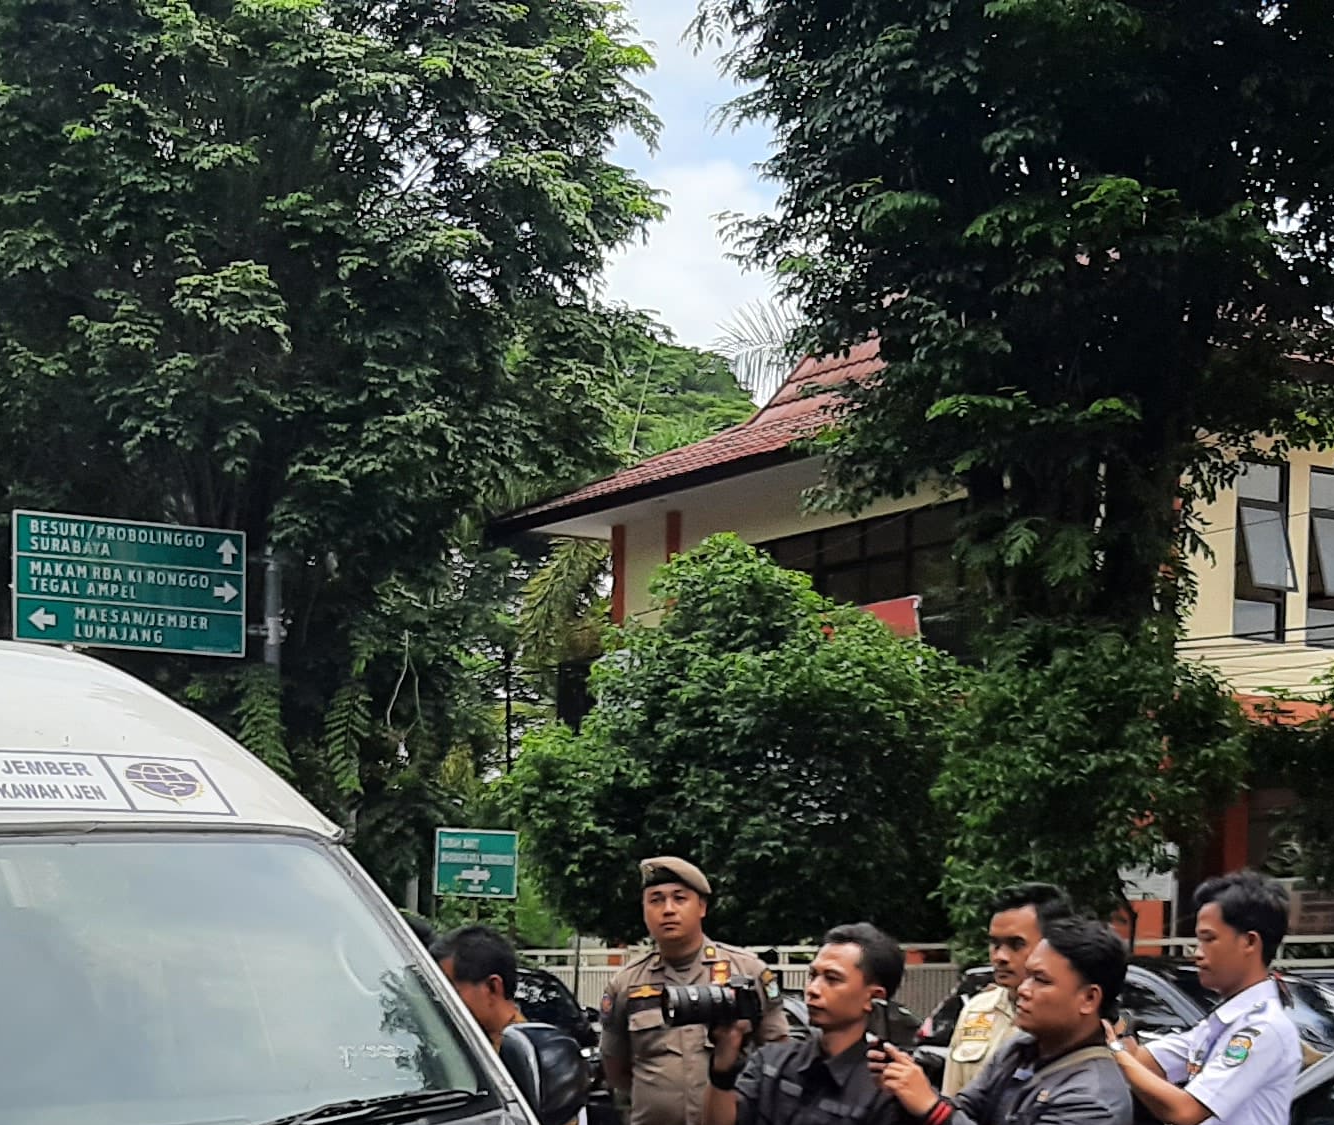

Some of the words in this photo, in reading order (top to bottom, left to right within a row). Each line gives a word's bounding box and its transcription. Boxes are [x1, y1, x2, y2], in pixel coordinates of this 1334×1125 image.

[30, 519, 205, 548] BESUKI/PROBOLINGGO
[30, 535, 111, 556] SURABAYA
[30, 561, 87, 578] MAKAM
[92, 566, 122, 581] RBA
[128, 569, 142, 583] KI
[147, 570, 209, 589] RONGGO
[30, 577, 79, 594] TEGAL
[87, 582, 136, 599] AMPEL
[74, 606, 208, 630] MAESAN/JEMBER
[74, 623, 163, 643] LUMAJANG
[1, 760, 92, 777] JEMBER
[67, 784, 107, 800] IJEN
